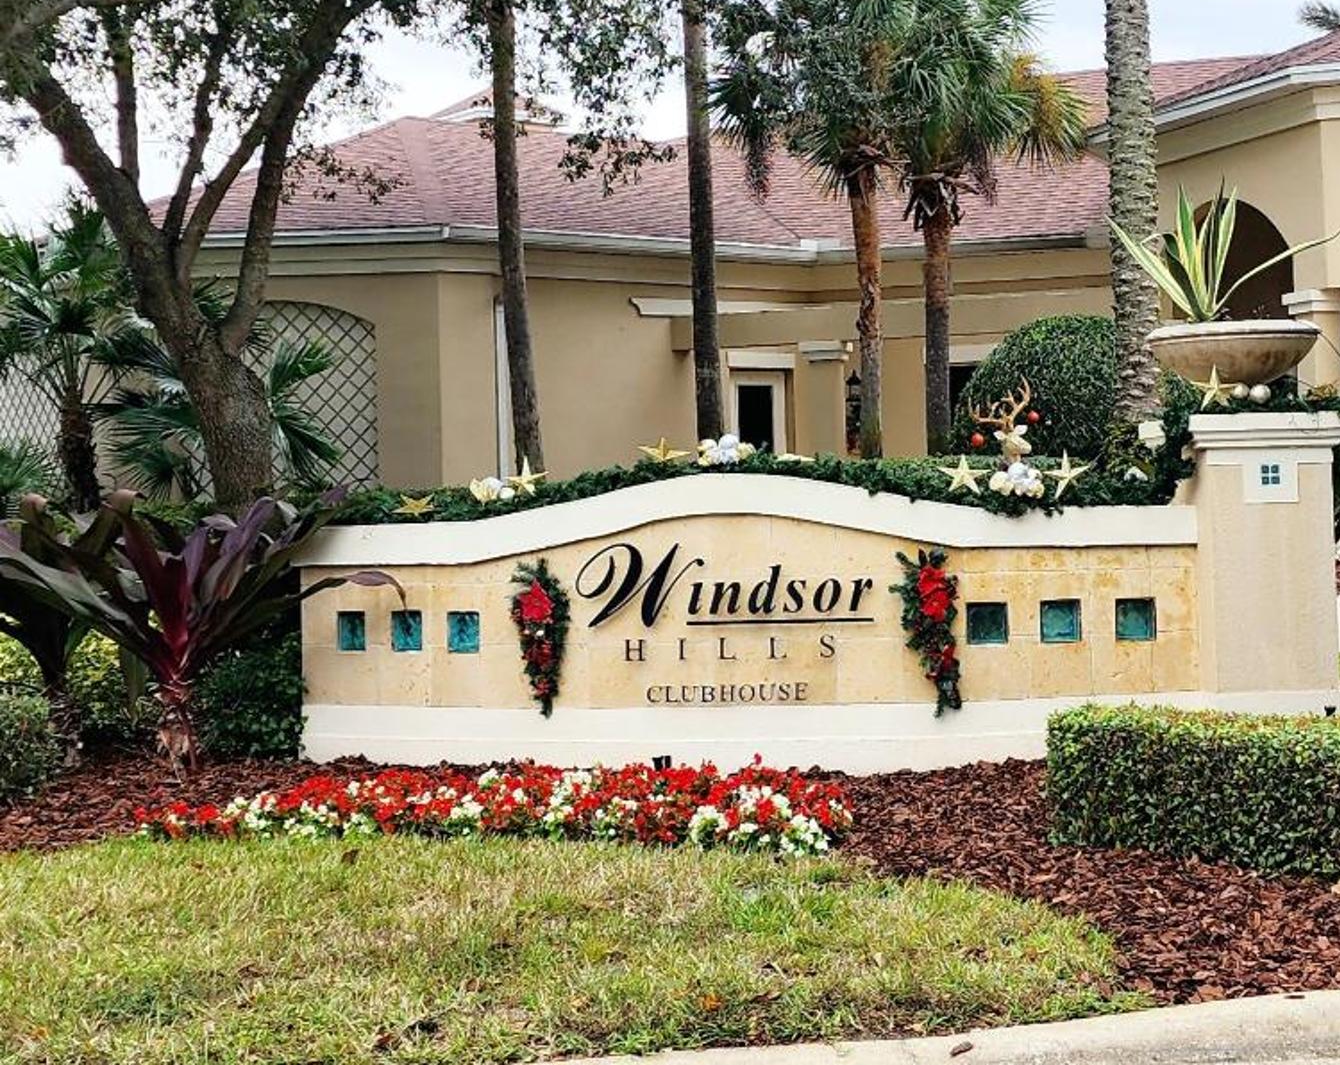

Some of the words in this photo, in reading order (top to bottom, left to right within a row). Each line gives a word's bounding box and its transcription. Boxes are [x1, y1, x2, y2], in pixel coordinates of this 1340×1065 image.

[575, 542, 873, 628] Windsor
[623, 635, 837, 662] HILLS
[646, 682, 808, 704] CLUBHOUSE
